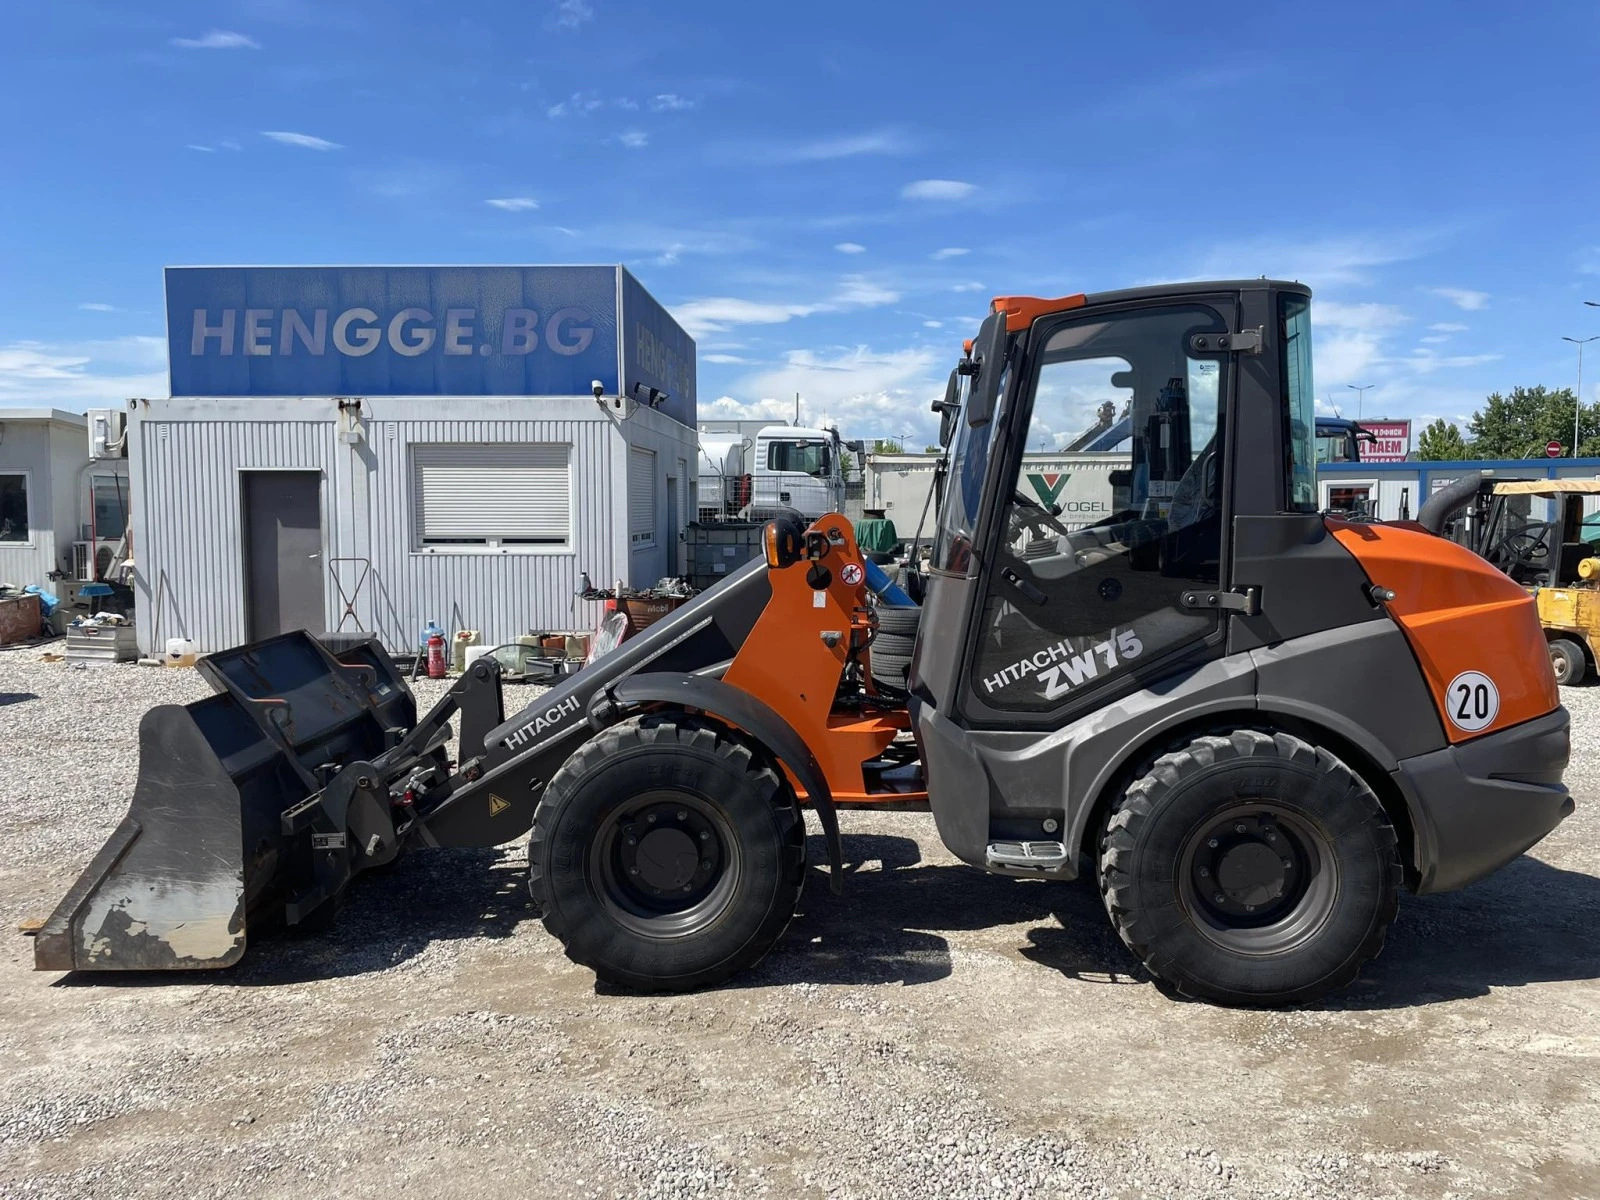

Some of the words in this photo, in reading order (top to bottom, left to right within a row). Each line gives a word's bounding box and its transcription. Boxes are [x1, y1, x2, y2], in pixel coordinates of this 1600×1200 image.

[191, 307, 594, 357] HENGGE.BG
[1369, 440, 1402, 453] НАЕМ
[1380, 428, 1403, 436] ОФИСИ
[1057, 501, 1111, 512] VOGEL
[983, 638, 1074, 693] HITACHI
[1036, 629, 1144, 700] ZW75
[1457, 683, 1488, 719] 20
[504, 695, 581, 751] HITACHI
